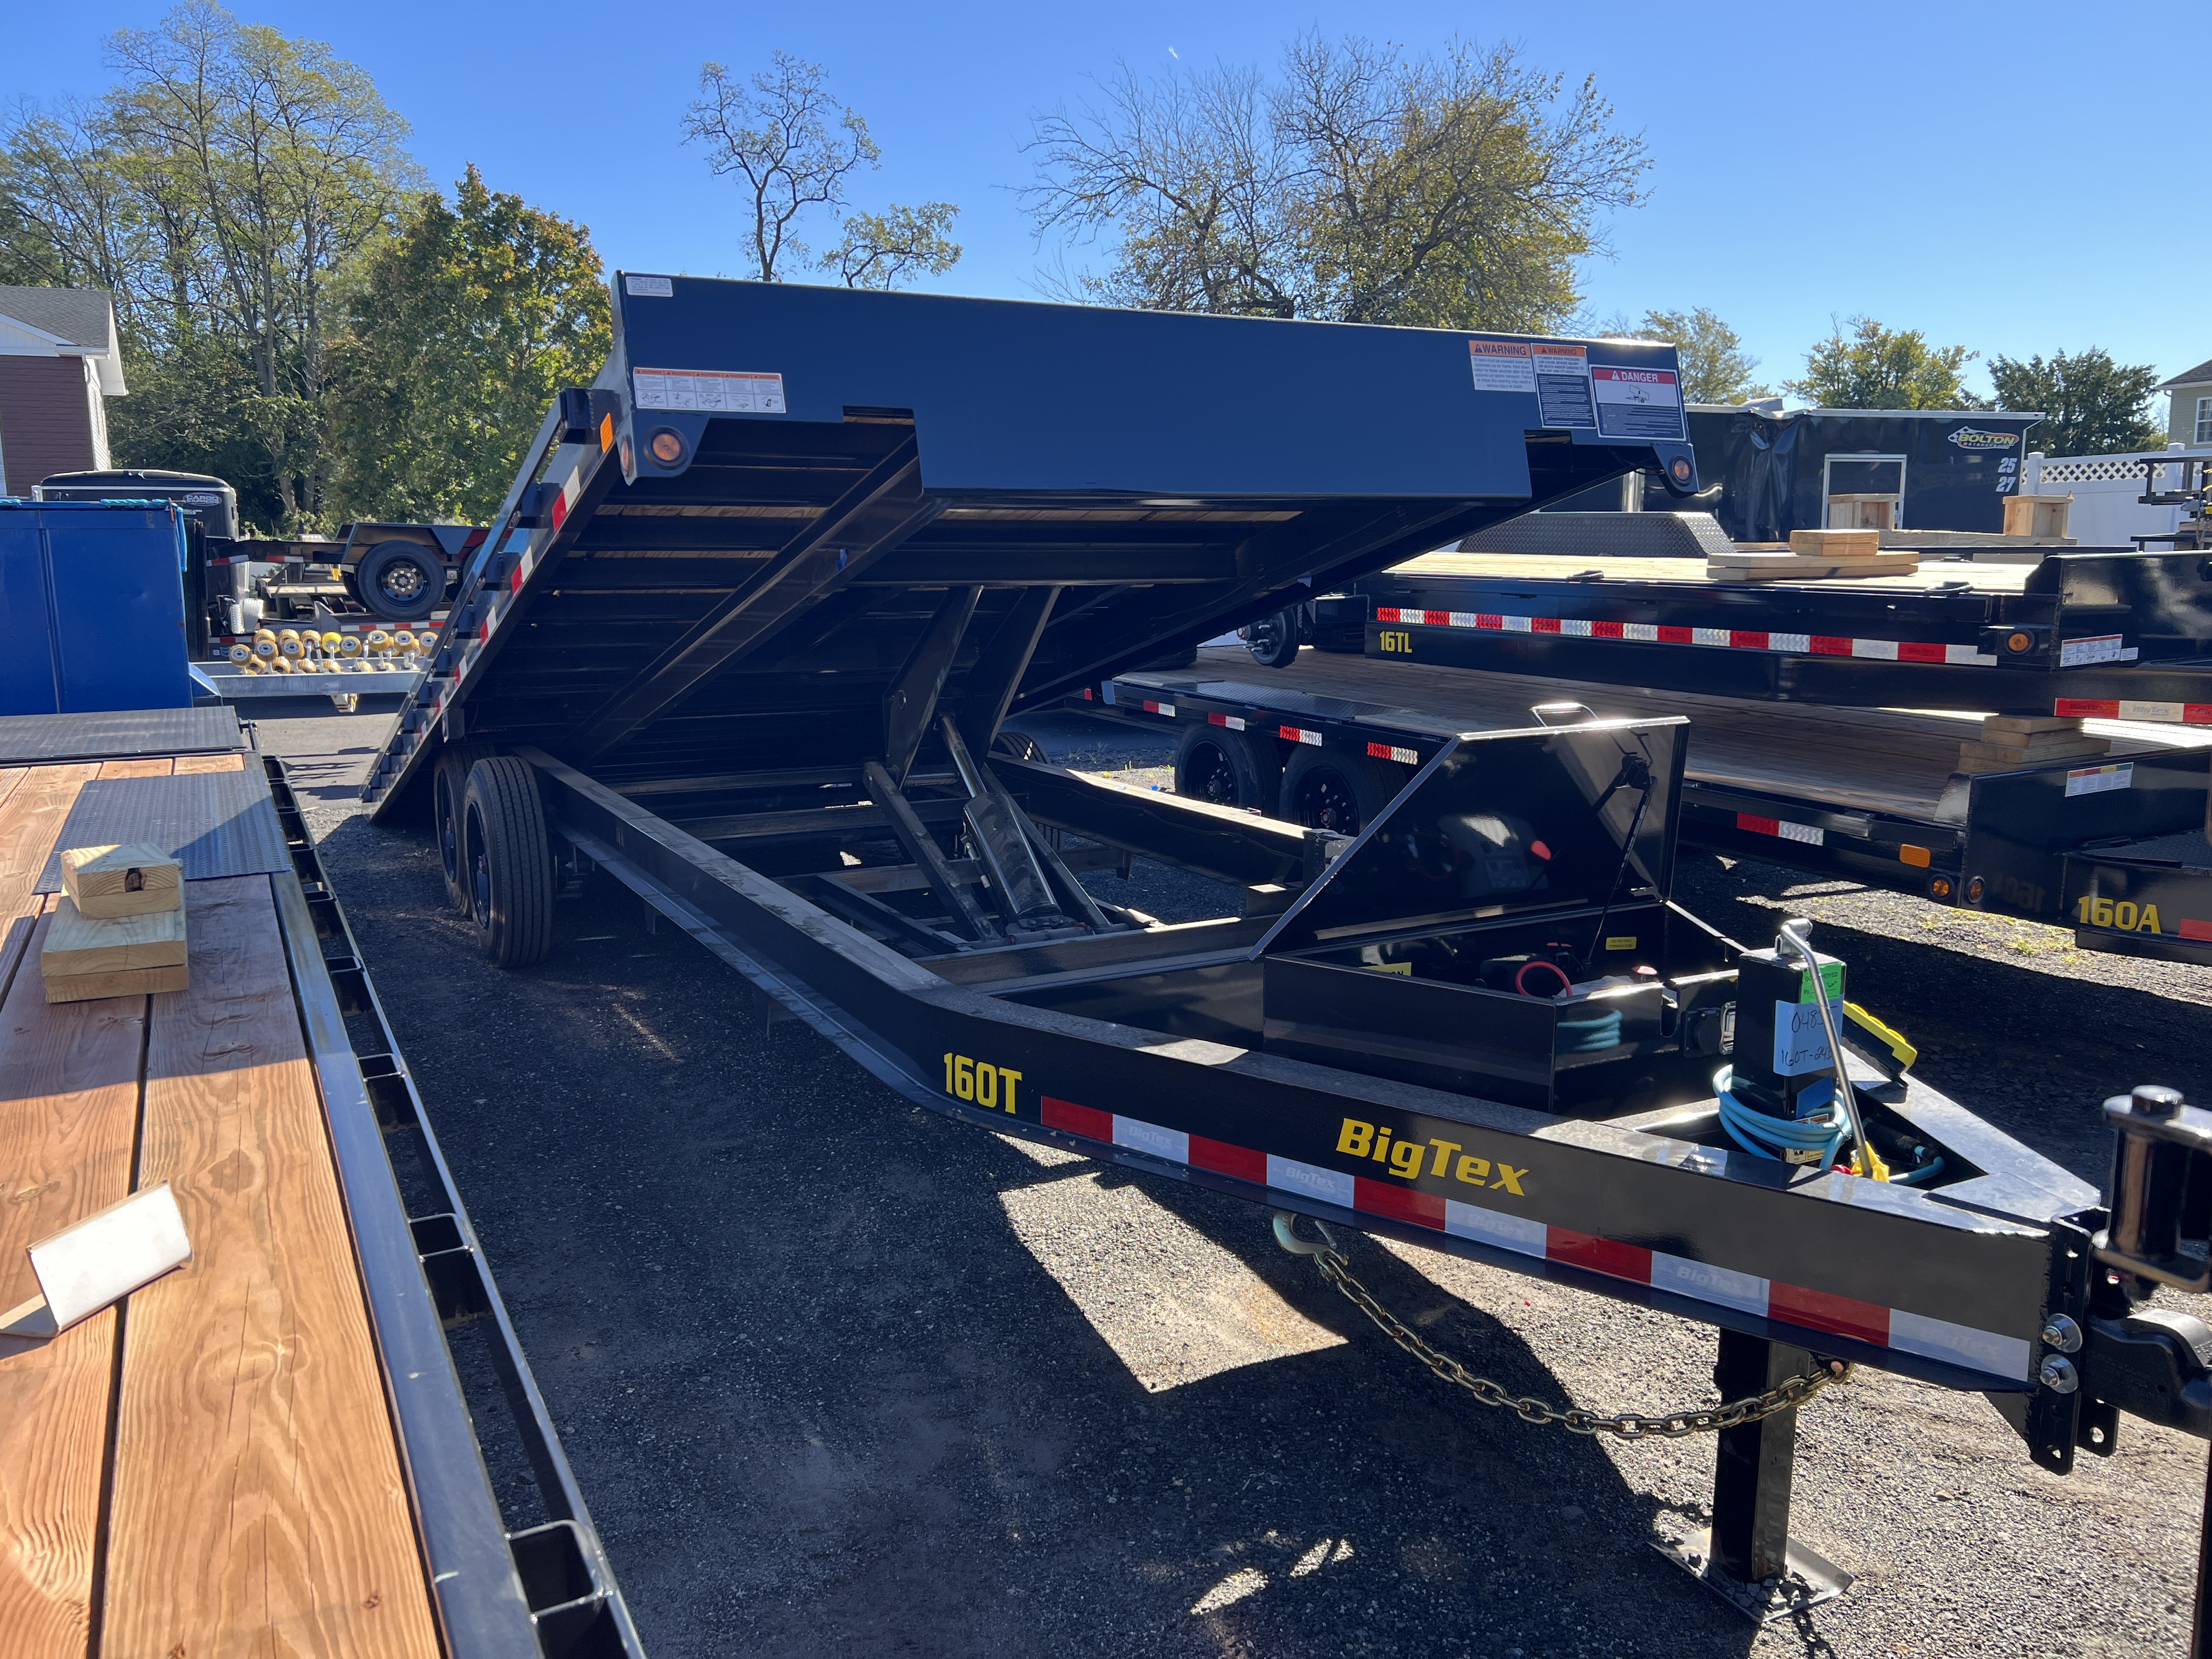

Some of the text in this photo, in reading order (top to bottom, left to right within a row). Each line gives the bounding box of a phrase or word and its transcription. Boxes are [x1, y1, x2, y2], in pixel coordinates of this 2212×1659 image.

[1482, 344, 1527, 356] WARNING
[1621, 371, 1658, 383] DANGER
[1958, 433, 2016, 445] BOLTON
[1997, 457, 2018, 473] 25
[1995, 476, 2017, 492] 27
[1379, 630, 1413, 653] 16TL
[1129, 1125, 1172, 1146] BigTex
[1336, 1118, 1530, 1197] BigTex
[1285, 1166, 1336, 1188] BigTex
[1677, 1266, 1743, 1294] BigTex
